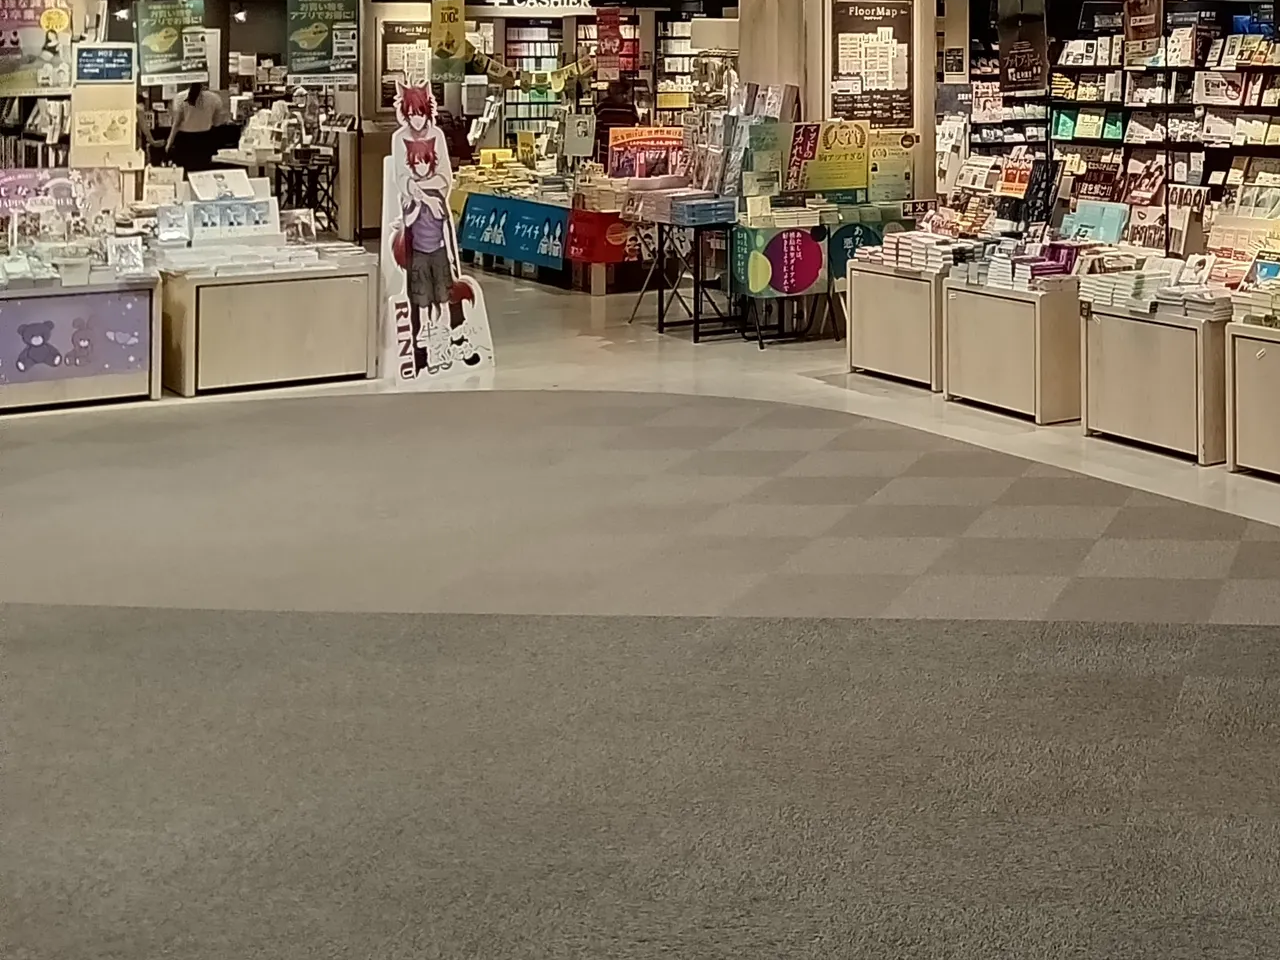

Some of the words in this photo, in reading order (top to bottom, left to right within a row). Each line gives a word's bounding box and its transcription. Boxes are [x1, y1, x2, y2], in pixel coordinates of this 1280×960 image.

[785, 124, 806, 190] イカれた青春
[804, 124, 819, 159] マッドの
